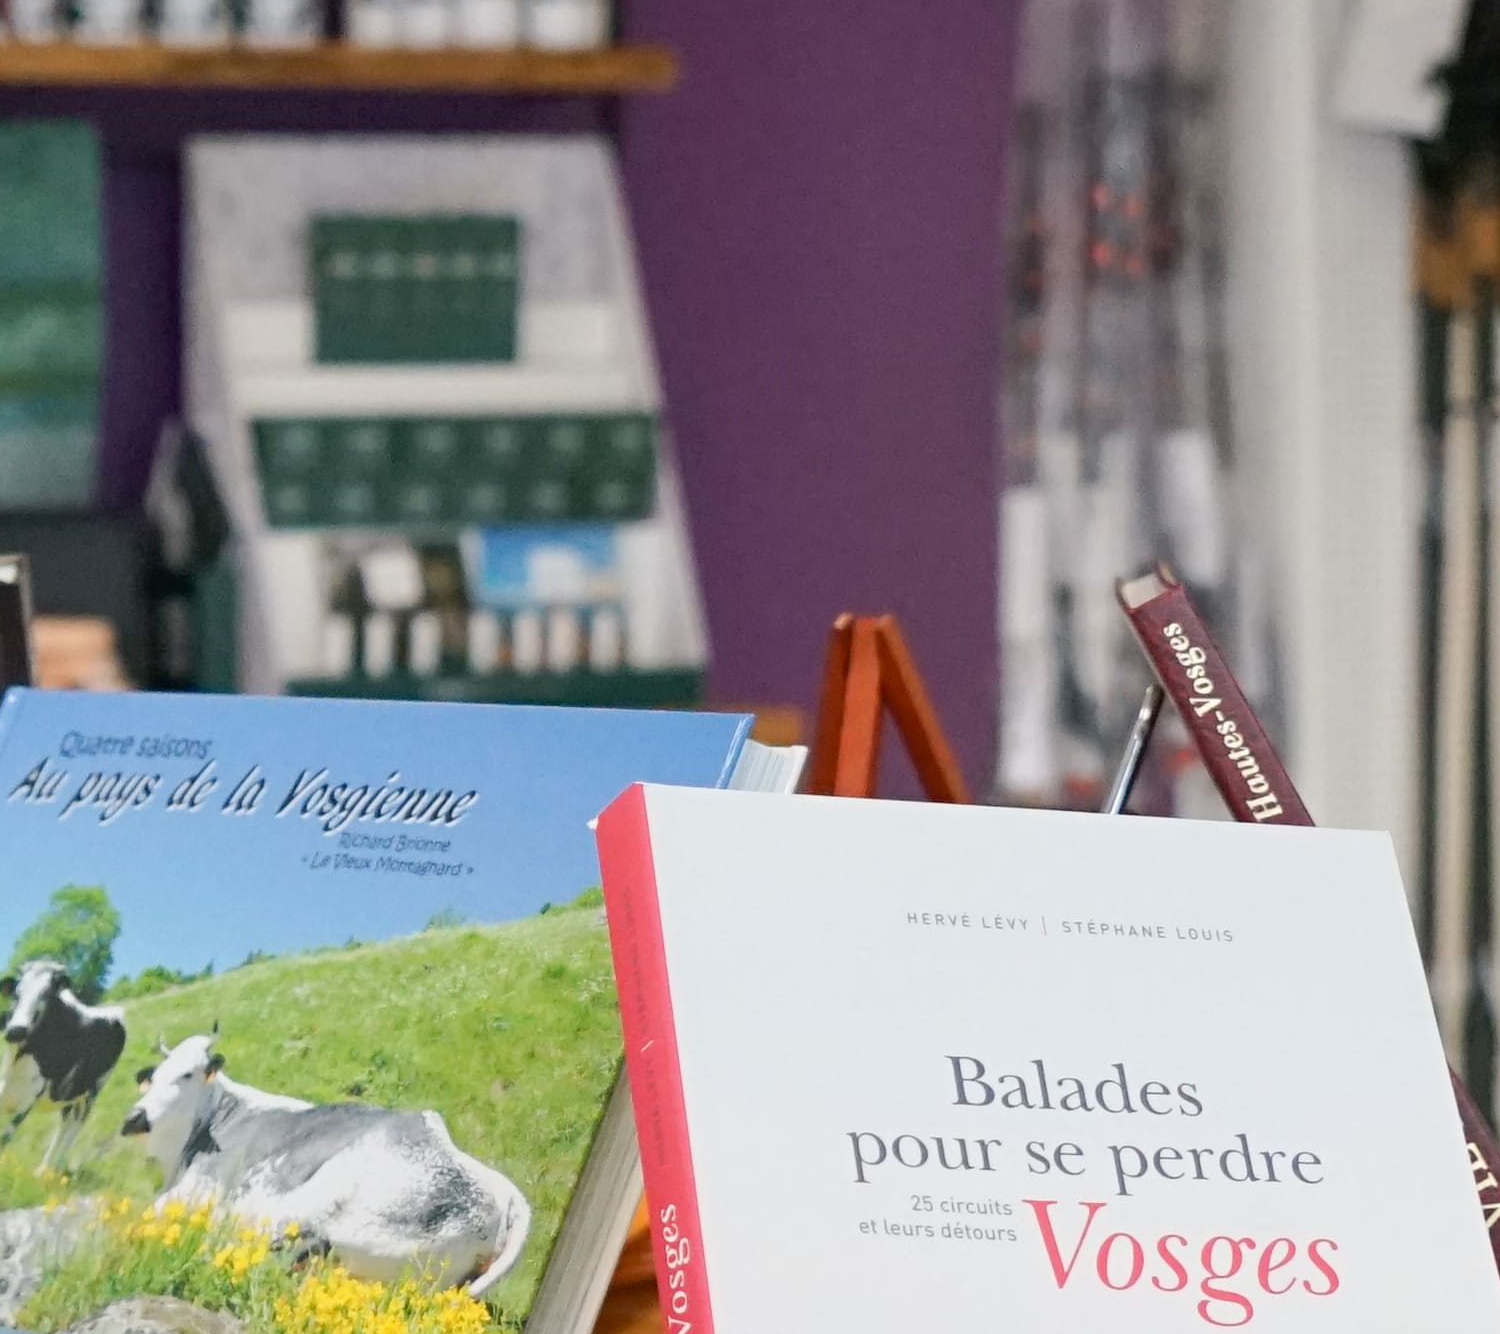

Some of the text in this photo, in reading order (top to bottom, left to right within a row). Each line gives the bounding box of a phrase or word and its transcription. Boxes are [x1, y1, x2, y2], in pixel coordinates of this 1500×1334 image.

[59, 730, 212, 760] Quatre saisons
[1163, 622, 1283, 822] Hautes-Vosges
[9, 756, 478, 835] Au pays de la Vosgienne
[906, 911, 1234, 943] HERVÉ LÉVY STÉPHANE LOUIS
[943, 1054, 1204, 1117] Balades
[845, 1130, 1325, 1197] pour se perdre
[858, 1219, 1018, 1243] et leurs détours
[910, 1195, 1014, 1217] 25 circuits
[1021, 1198, 1340, 1327] Vosges
